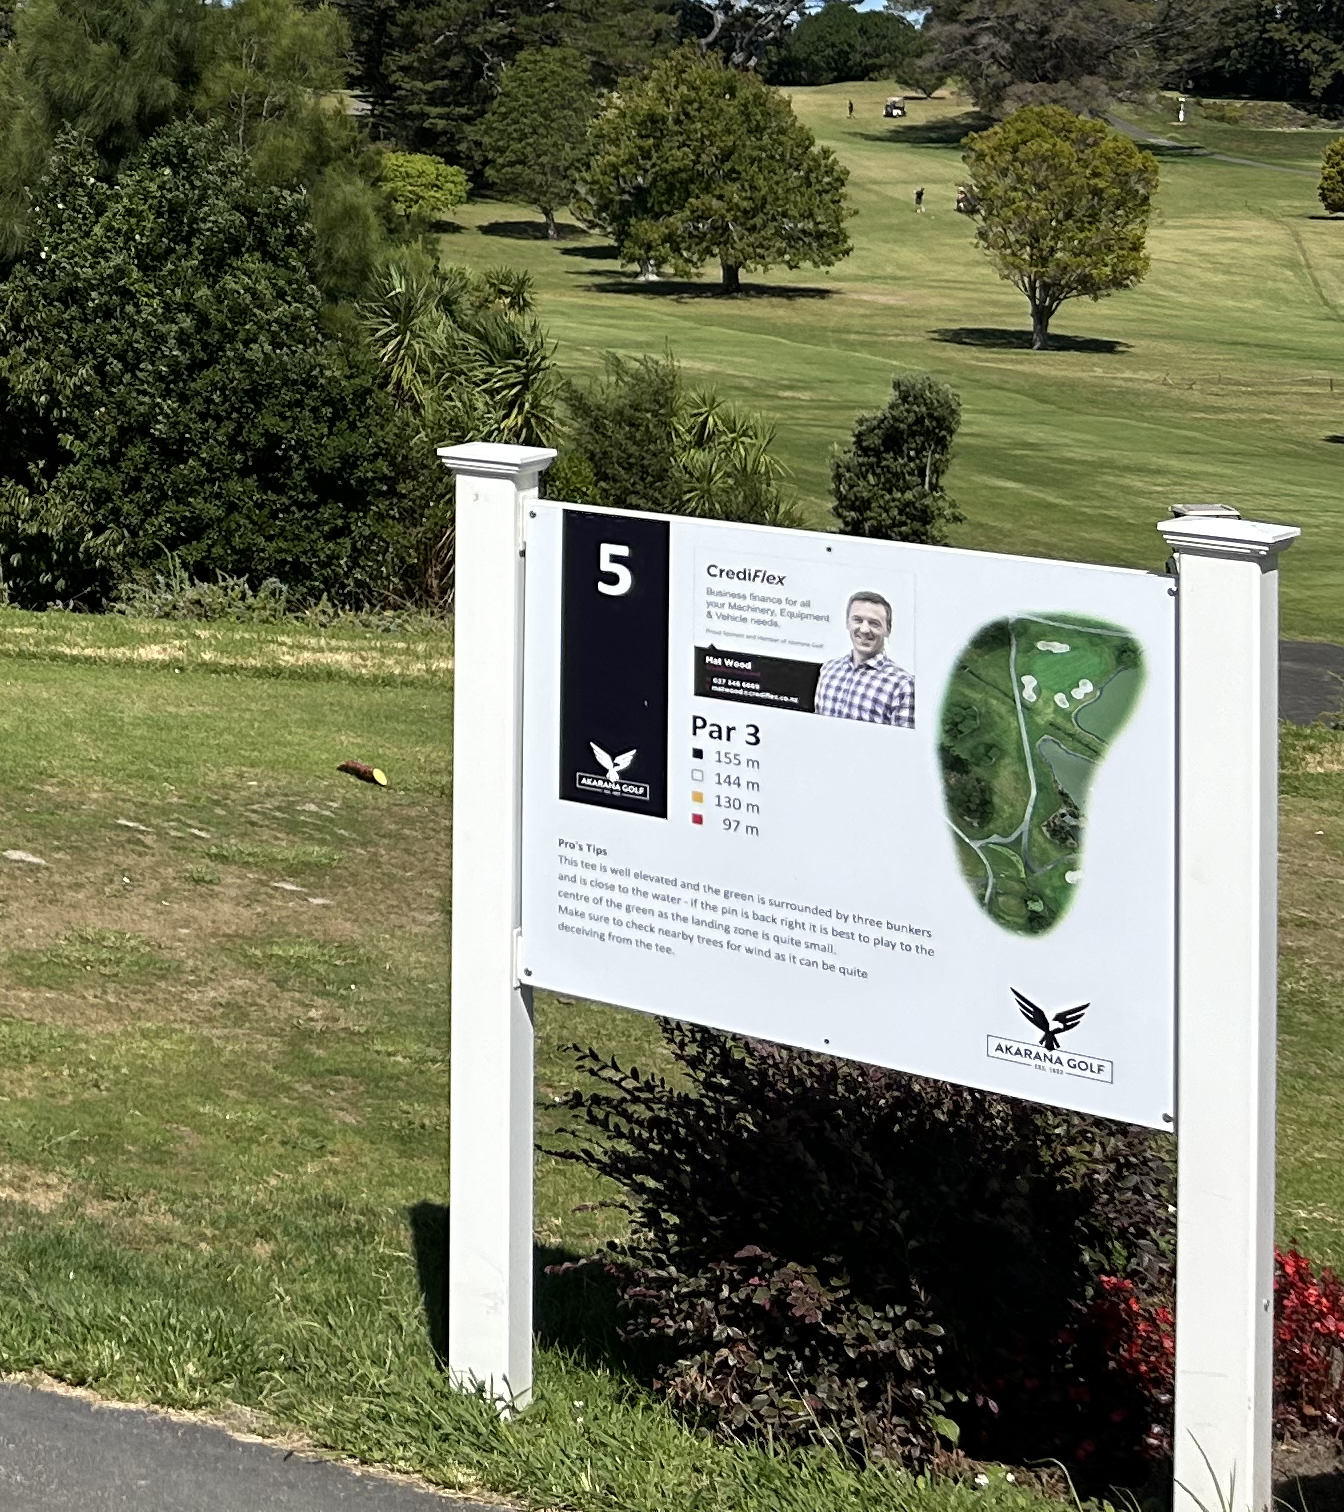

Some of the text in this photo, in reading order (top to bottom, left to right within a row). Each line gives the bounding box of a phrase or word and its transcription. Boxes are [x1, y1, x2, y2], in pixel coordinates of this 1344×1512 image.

[598, 543, 632, 596] 5
[707, 564, 787, 587] CrediFlex
[706, 587, 811, 608] Business finance for all
[706, 600, 830, 623] your Machinery, Equipment
[706, 610, 781, 628] & Vehicle needs.
[724, 658, 752, 670] Wood
[692, 714, 761, 746] Par 3
[715, 750, 760, 770] 155 m
[580, 777, 621, 791] AKARANA
[622, 784, 645, 795] GOLF
[714, 772, 760, 792] 144 m
[714, 794, 760, 815] 130 m
[722, 818, 759, 837] 97 m
[558, 838, 608, 857] Pro's Tips
[558, 854, 933, 938] This tee is well elevated and the green is surrounded by three bunkers
[558, 873, 577, 884] and
[579, 876, 588, 886] is
[589, 878, 616, 892] close
[618, 883, 629, 894] to
[631, 886, 649, 899] the
[651, 891, 682, 905] water
[690, 898, 698, 908] if
[700, 900, 719, 913] the
[721, 904, 738, 917] pin
[741, 908, 750, 920] is
[752, 910, 778, 925] back
[780, 916, 806, 931] right
[809, 922, 817, 933] it
[819, 924, 829, 936] is
[831, 926, 856, 941] best
[858, 932, 870, 944] to
[873, 935, 897, 951] play
[899, 941, 912, 953] to
[915, 943, 935, 957] the
[558, 889, 837, 955] centre of the green as the landing zone is quite small.
[558, 922, 676, 956] deceiving from the tee.
[558, 904, 869, 979] Make sure to check nearby trees for wind as it can be quite
[995, 1042, 1105, 1075] AKARANA GOLF
